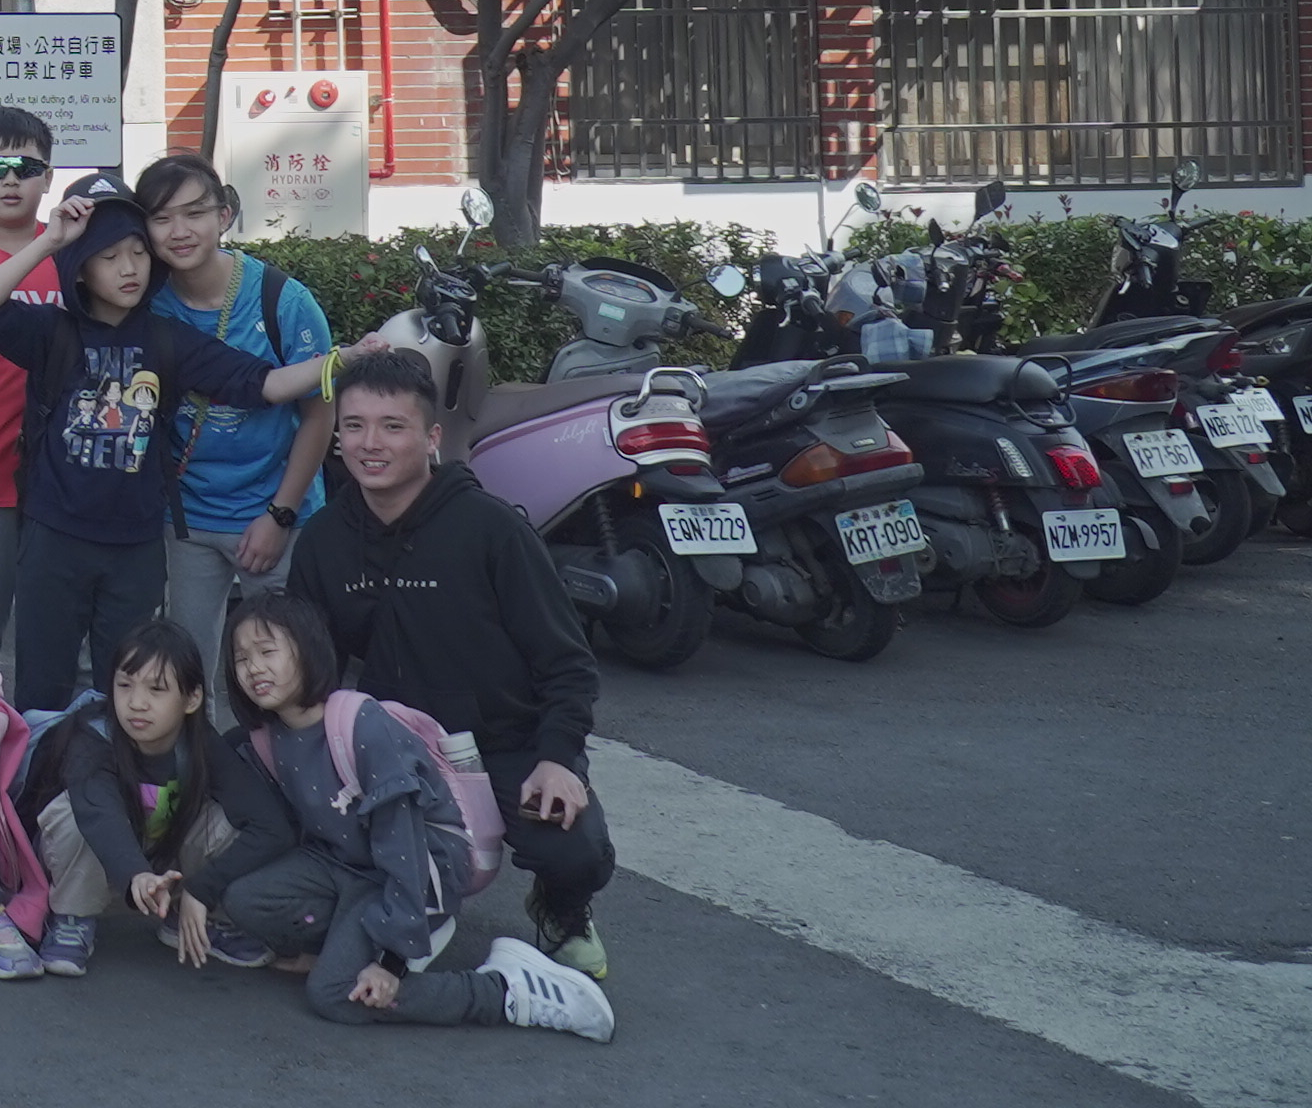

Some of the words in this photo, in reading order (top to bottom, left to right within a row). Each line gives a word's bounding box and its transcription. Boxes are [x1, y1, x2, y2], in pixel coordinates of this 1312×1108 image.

[264, 153, 332, 172] 消防栓
[271, 174, 324, 185] HYDRANT
[396, 578, 438, 587] Dream
